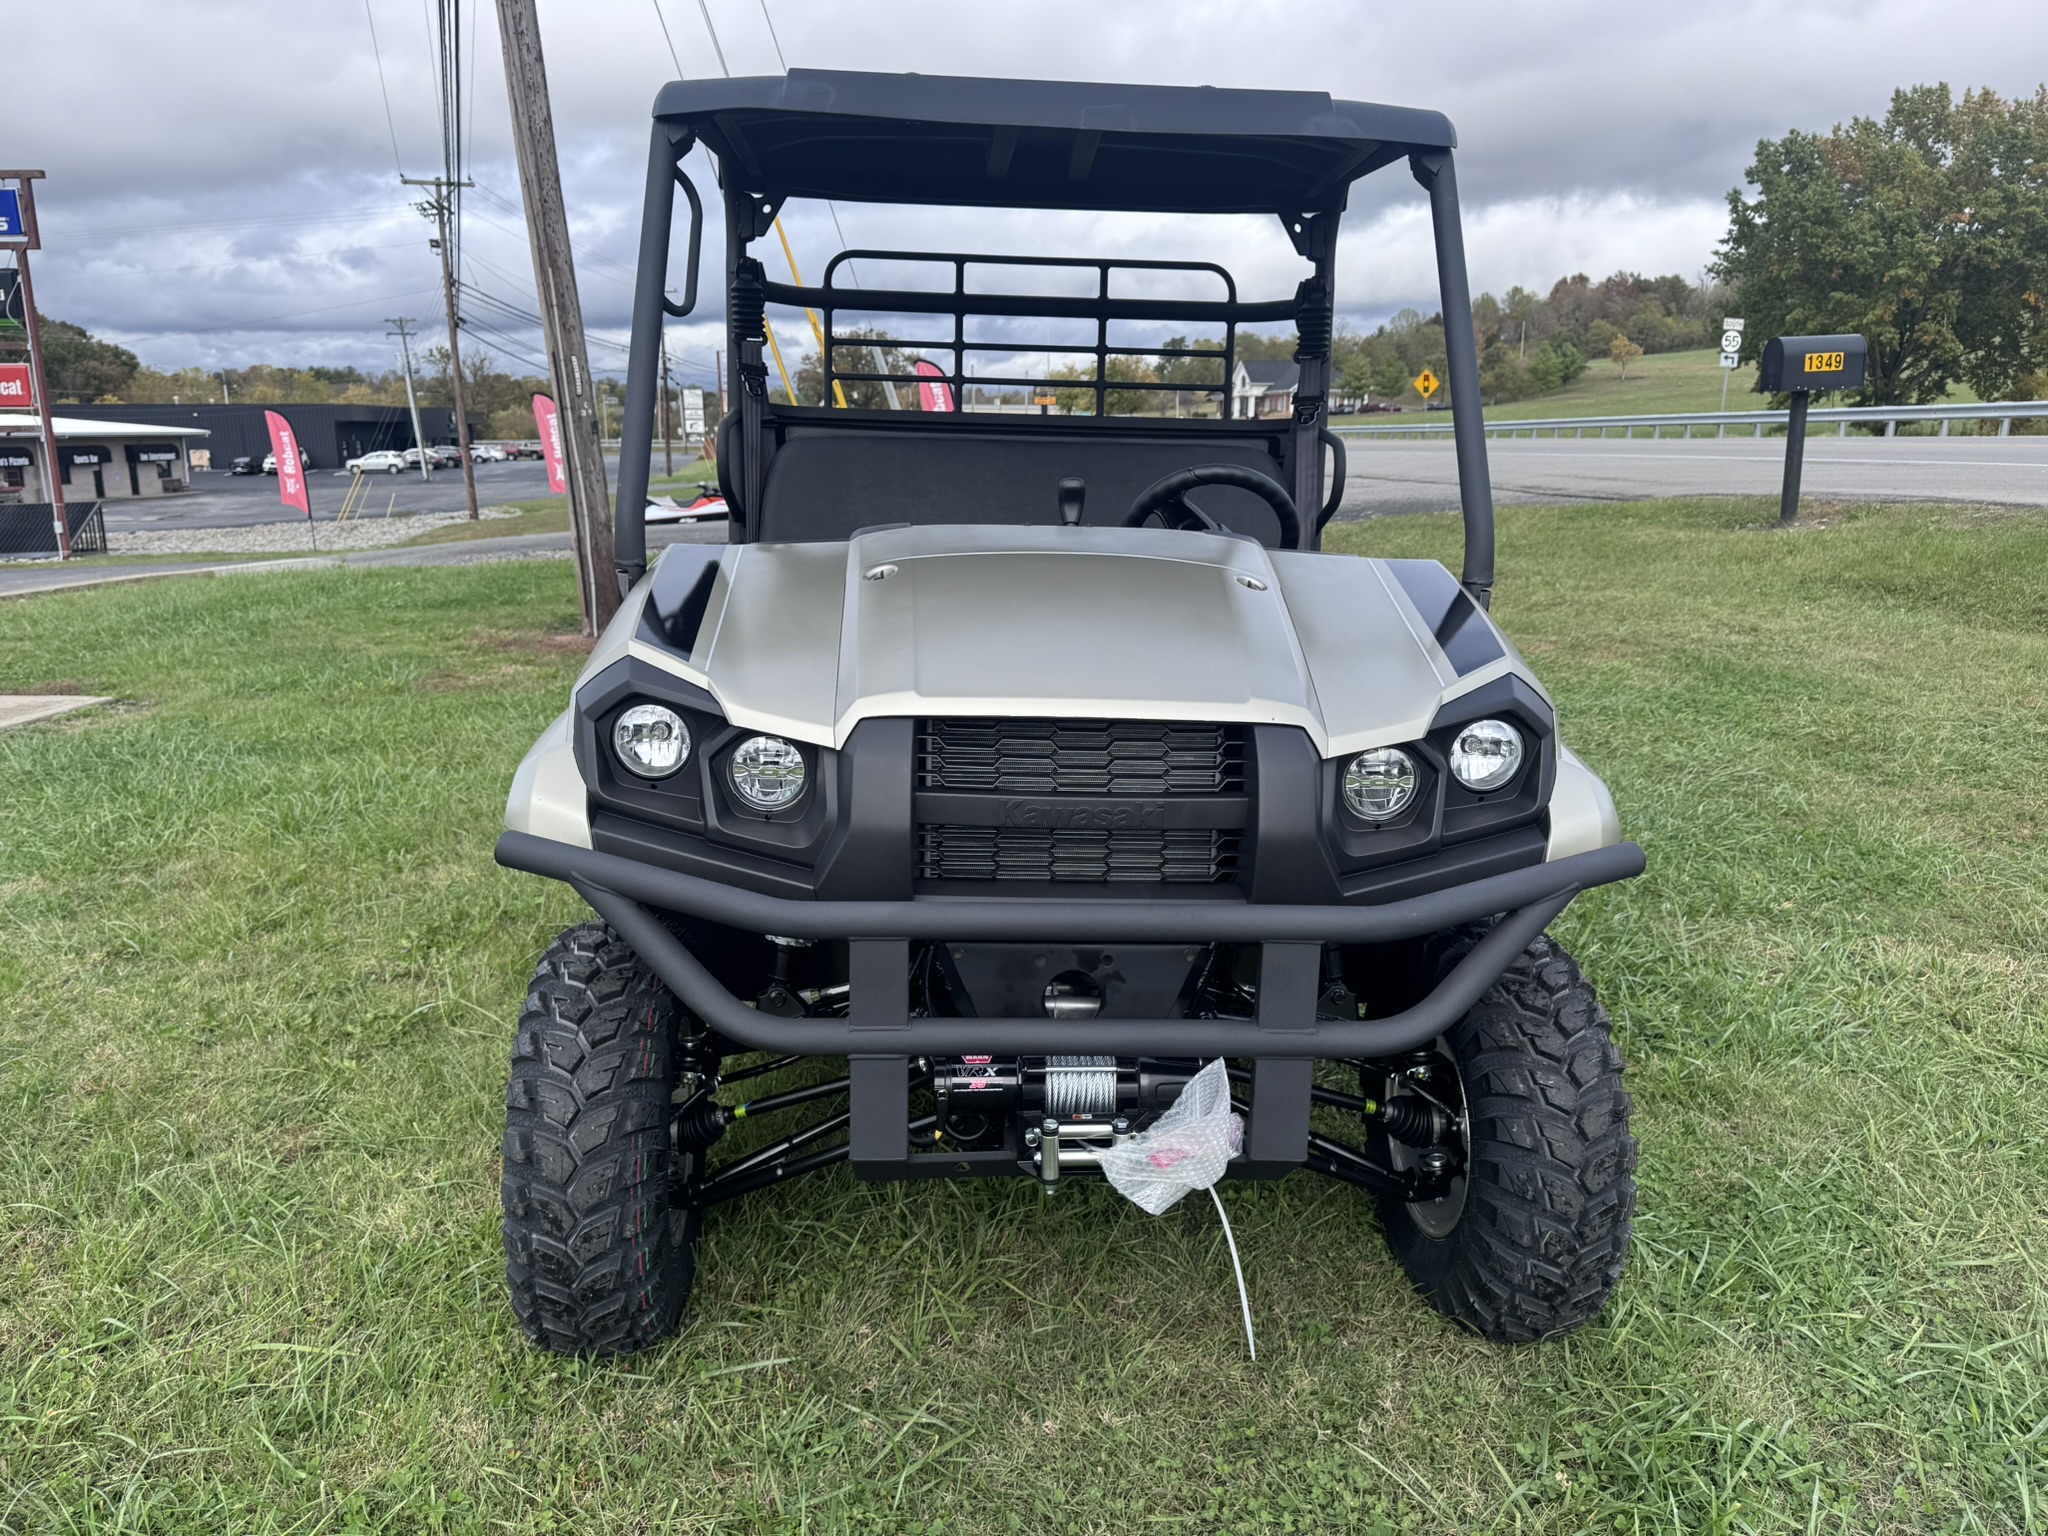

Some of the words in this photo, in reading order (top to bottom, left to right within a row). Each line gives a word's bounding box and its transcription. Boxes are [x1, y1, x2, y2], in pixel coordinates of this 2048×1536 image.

[1724, 335, 1740, 348] 55
[1808, 354, 1842, 370] 1349
[0, 379, 23, 396] cat
[279, 431, 297, 475] Bobcat
[998, 799, 1166, 829] Kawasaki
[955, 1064, 999, 1077] VRX
